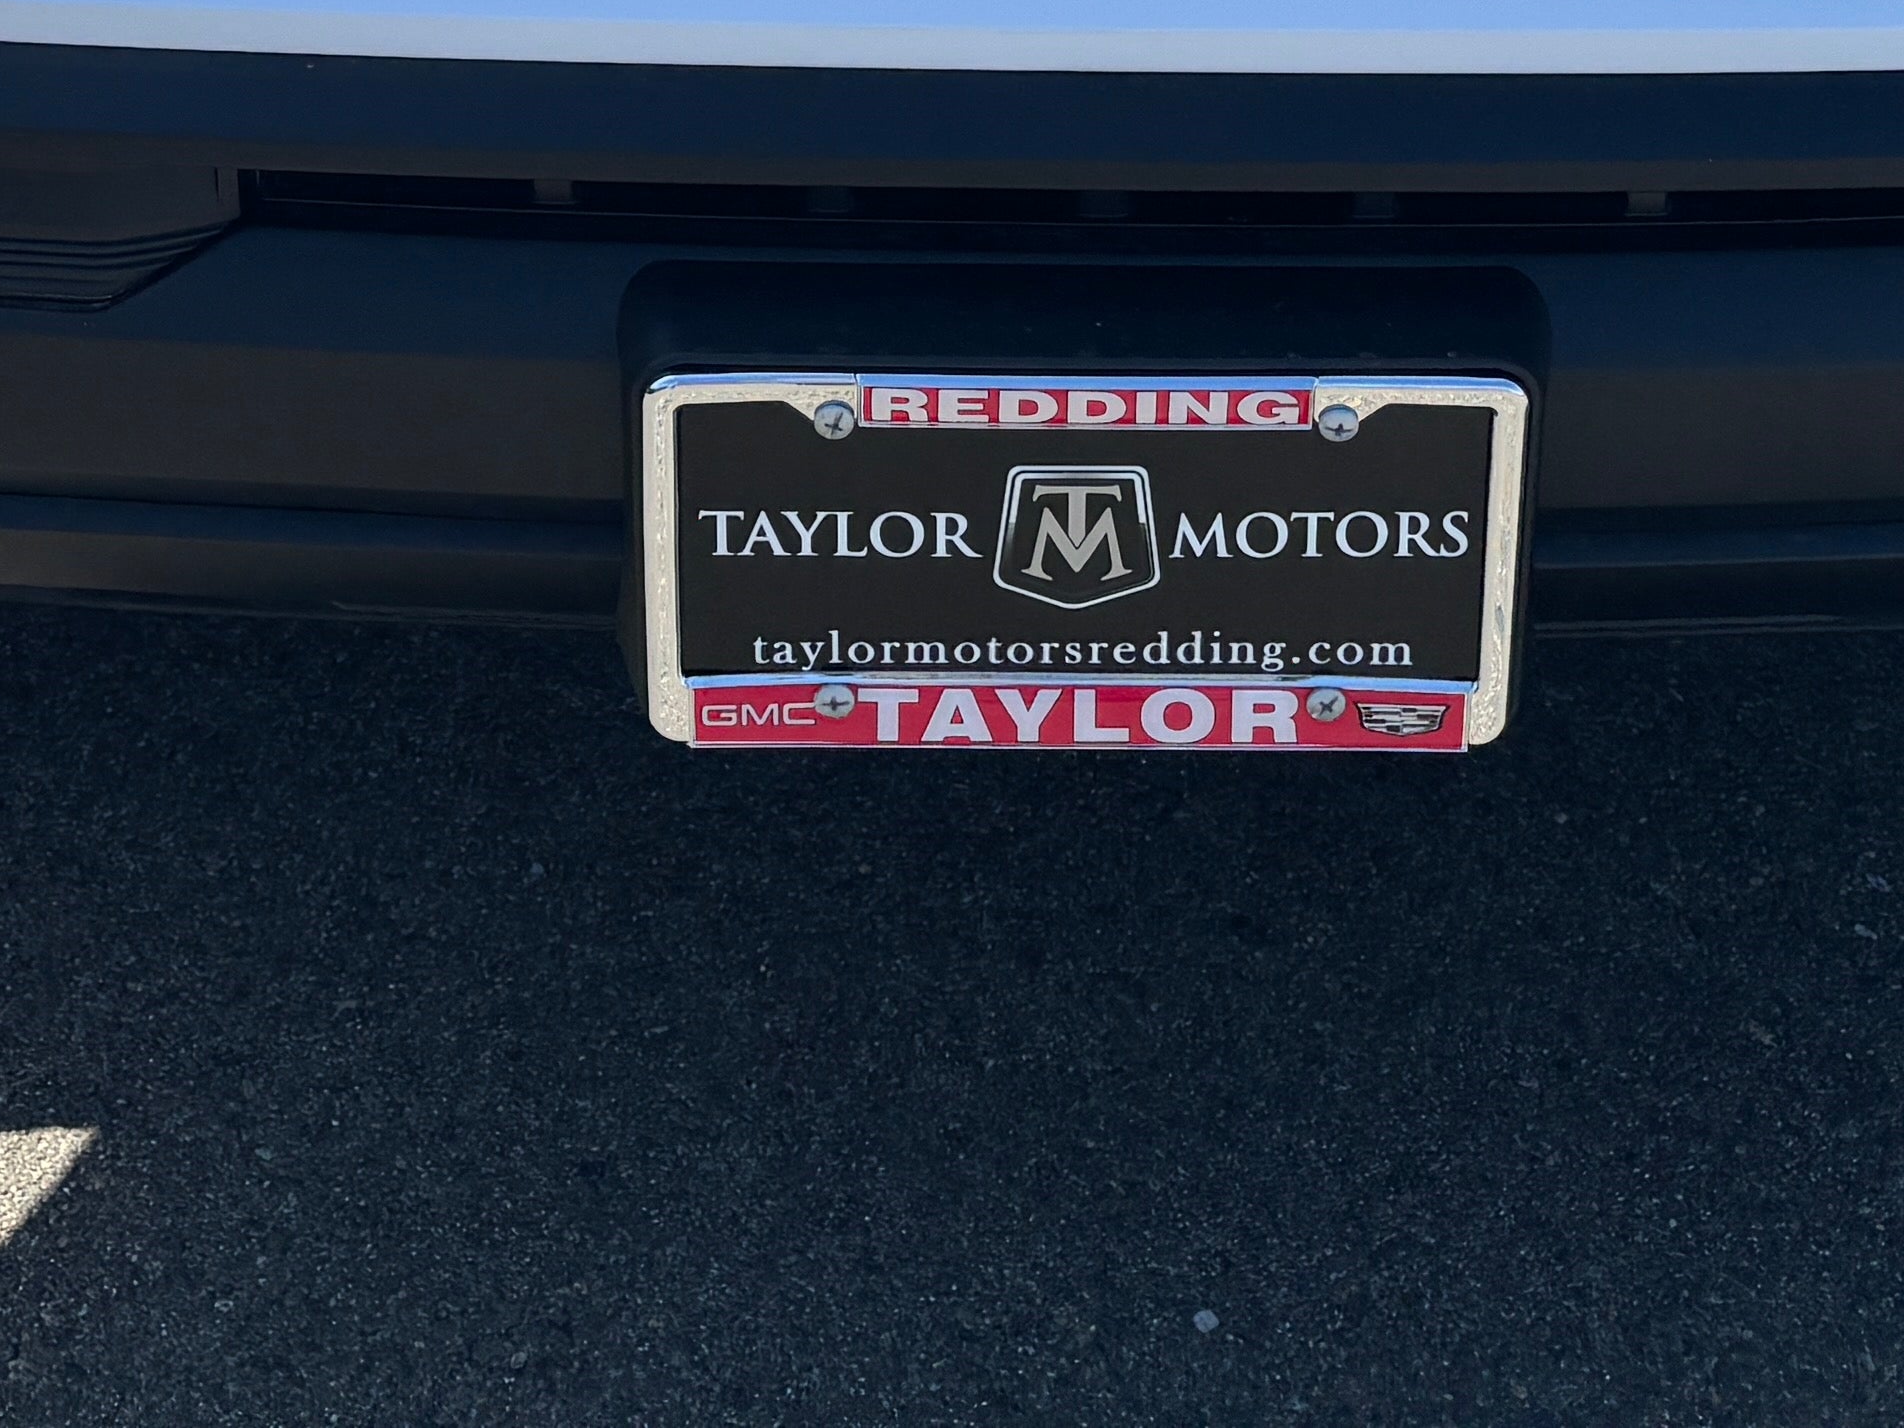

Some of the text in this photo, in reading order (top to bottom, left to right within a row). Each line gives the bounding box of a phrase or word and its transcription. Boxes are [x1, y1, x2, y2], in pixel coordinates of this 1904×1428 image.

[864, 387, 1299, 426] REDDING
[698, 509, 1471, 559] TAYLOR MOTORS
[752, 630, 1413, 672] taylormotorsredding.com
[700, 687, 1299, 744] GMC TAYLOR
